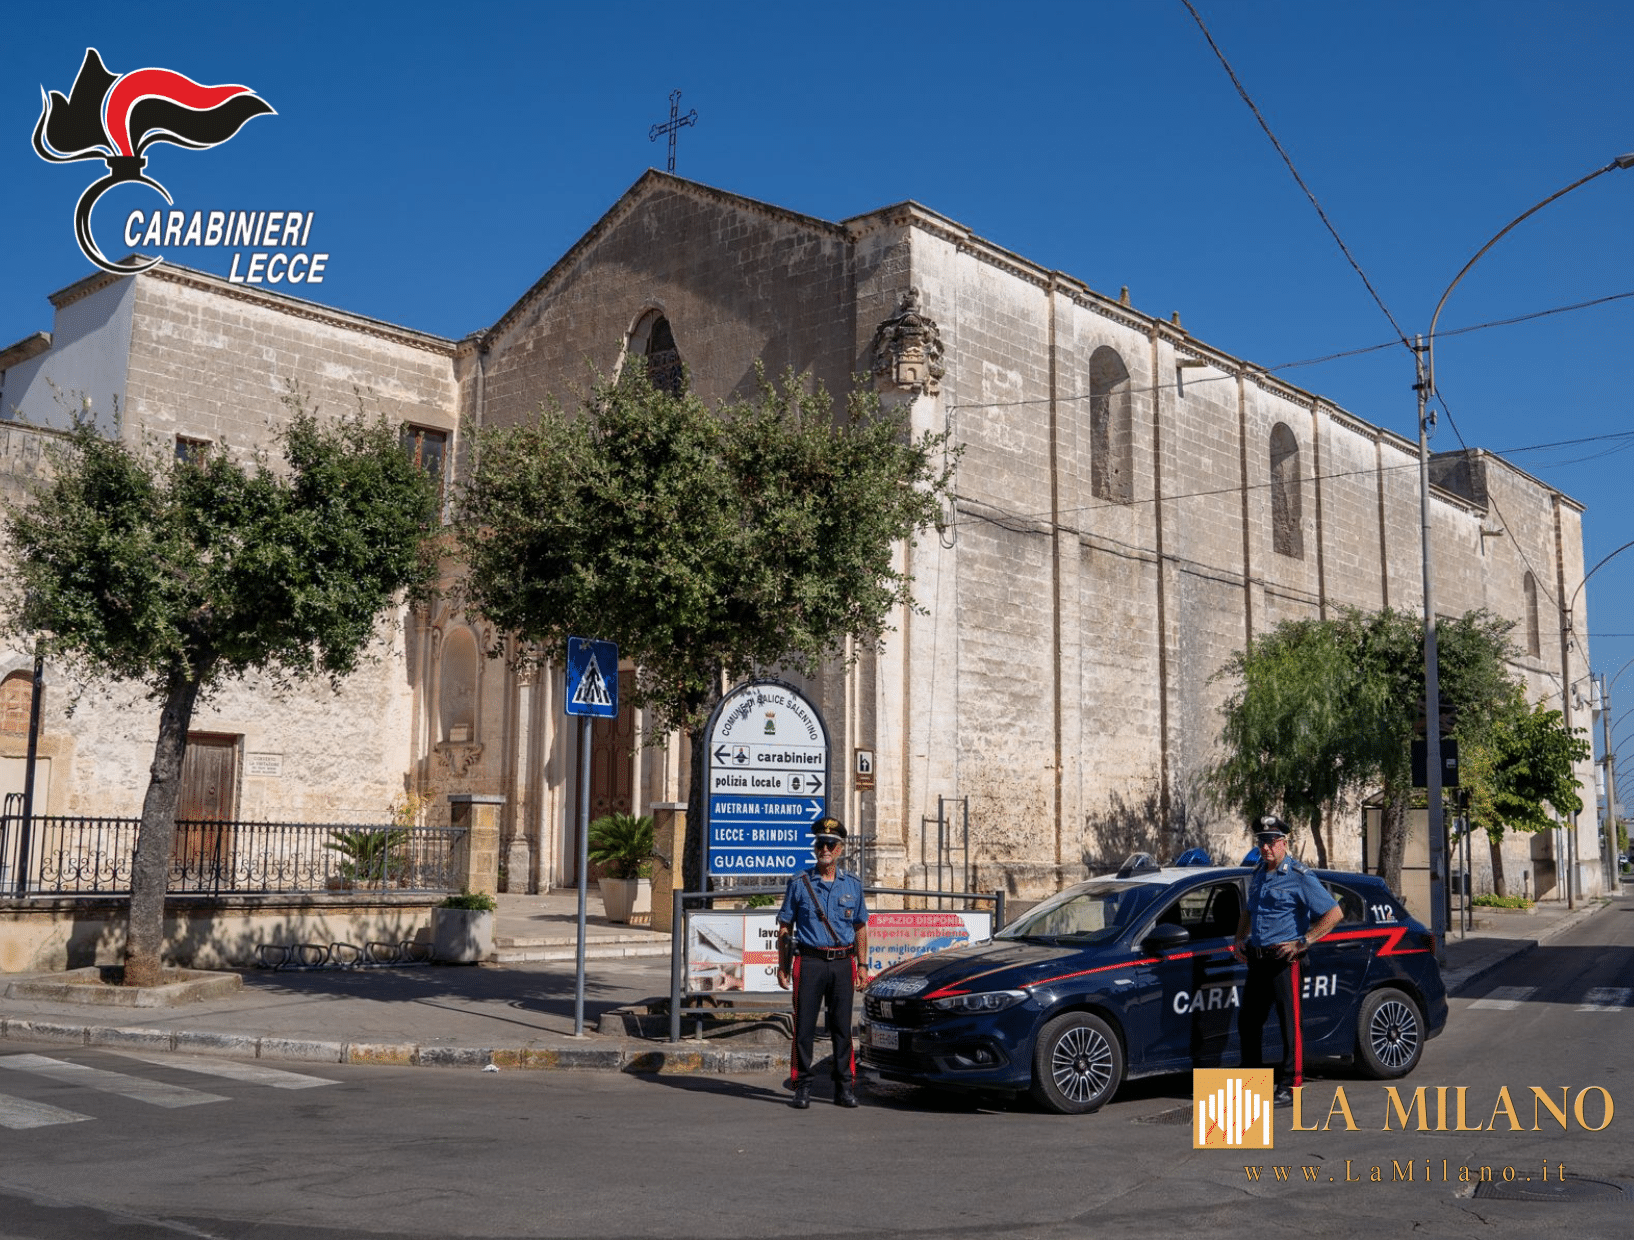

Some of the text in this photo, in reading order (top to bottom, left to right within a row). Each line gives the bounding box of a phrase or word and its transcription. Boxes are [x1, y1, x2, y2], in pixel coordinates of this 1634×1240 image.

[722, 703, 746, 737] COMUNE
[786, 700, 818, 741] SALENTINO
[757, 752, 822, 764] carabinieri
[716, 775, 781, 788] polizia locale
[715, 828, 744, 841] LECCE
[752, 829, 798, 842] BRINDISI
[714, 855, 796, 868] GUAGNANO
[1370, 904, 1396, 921] 112
[876, 916, 911, 925] SPAZIO
[869, 944, 937, 956] per migliorare
[868, 957, 882, 969] la
